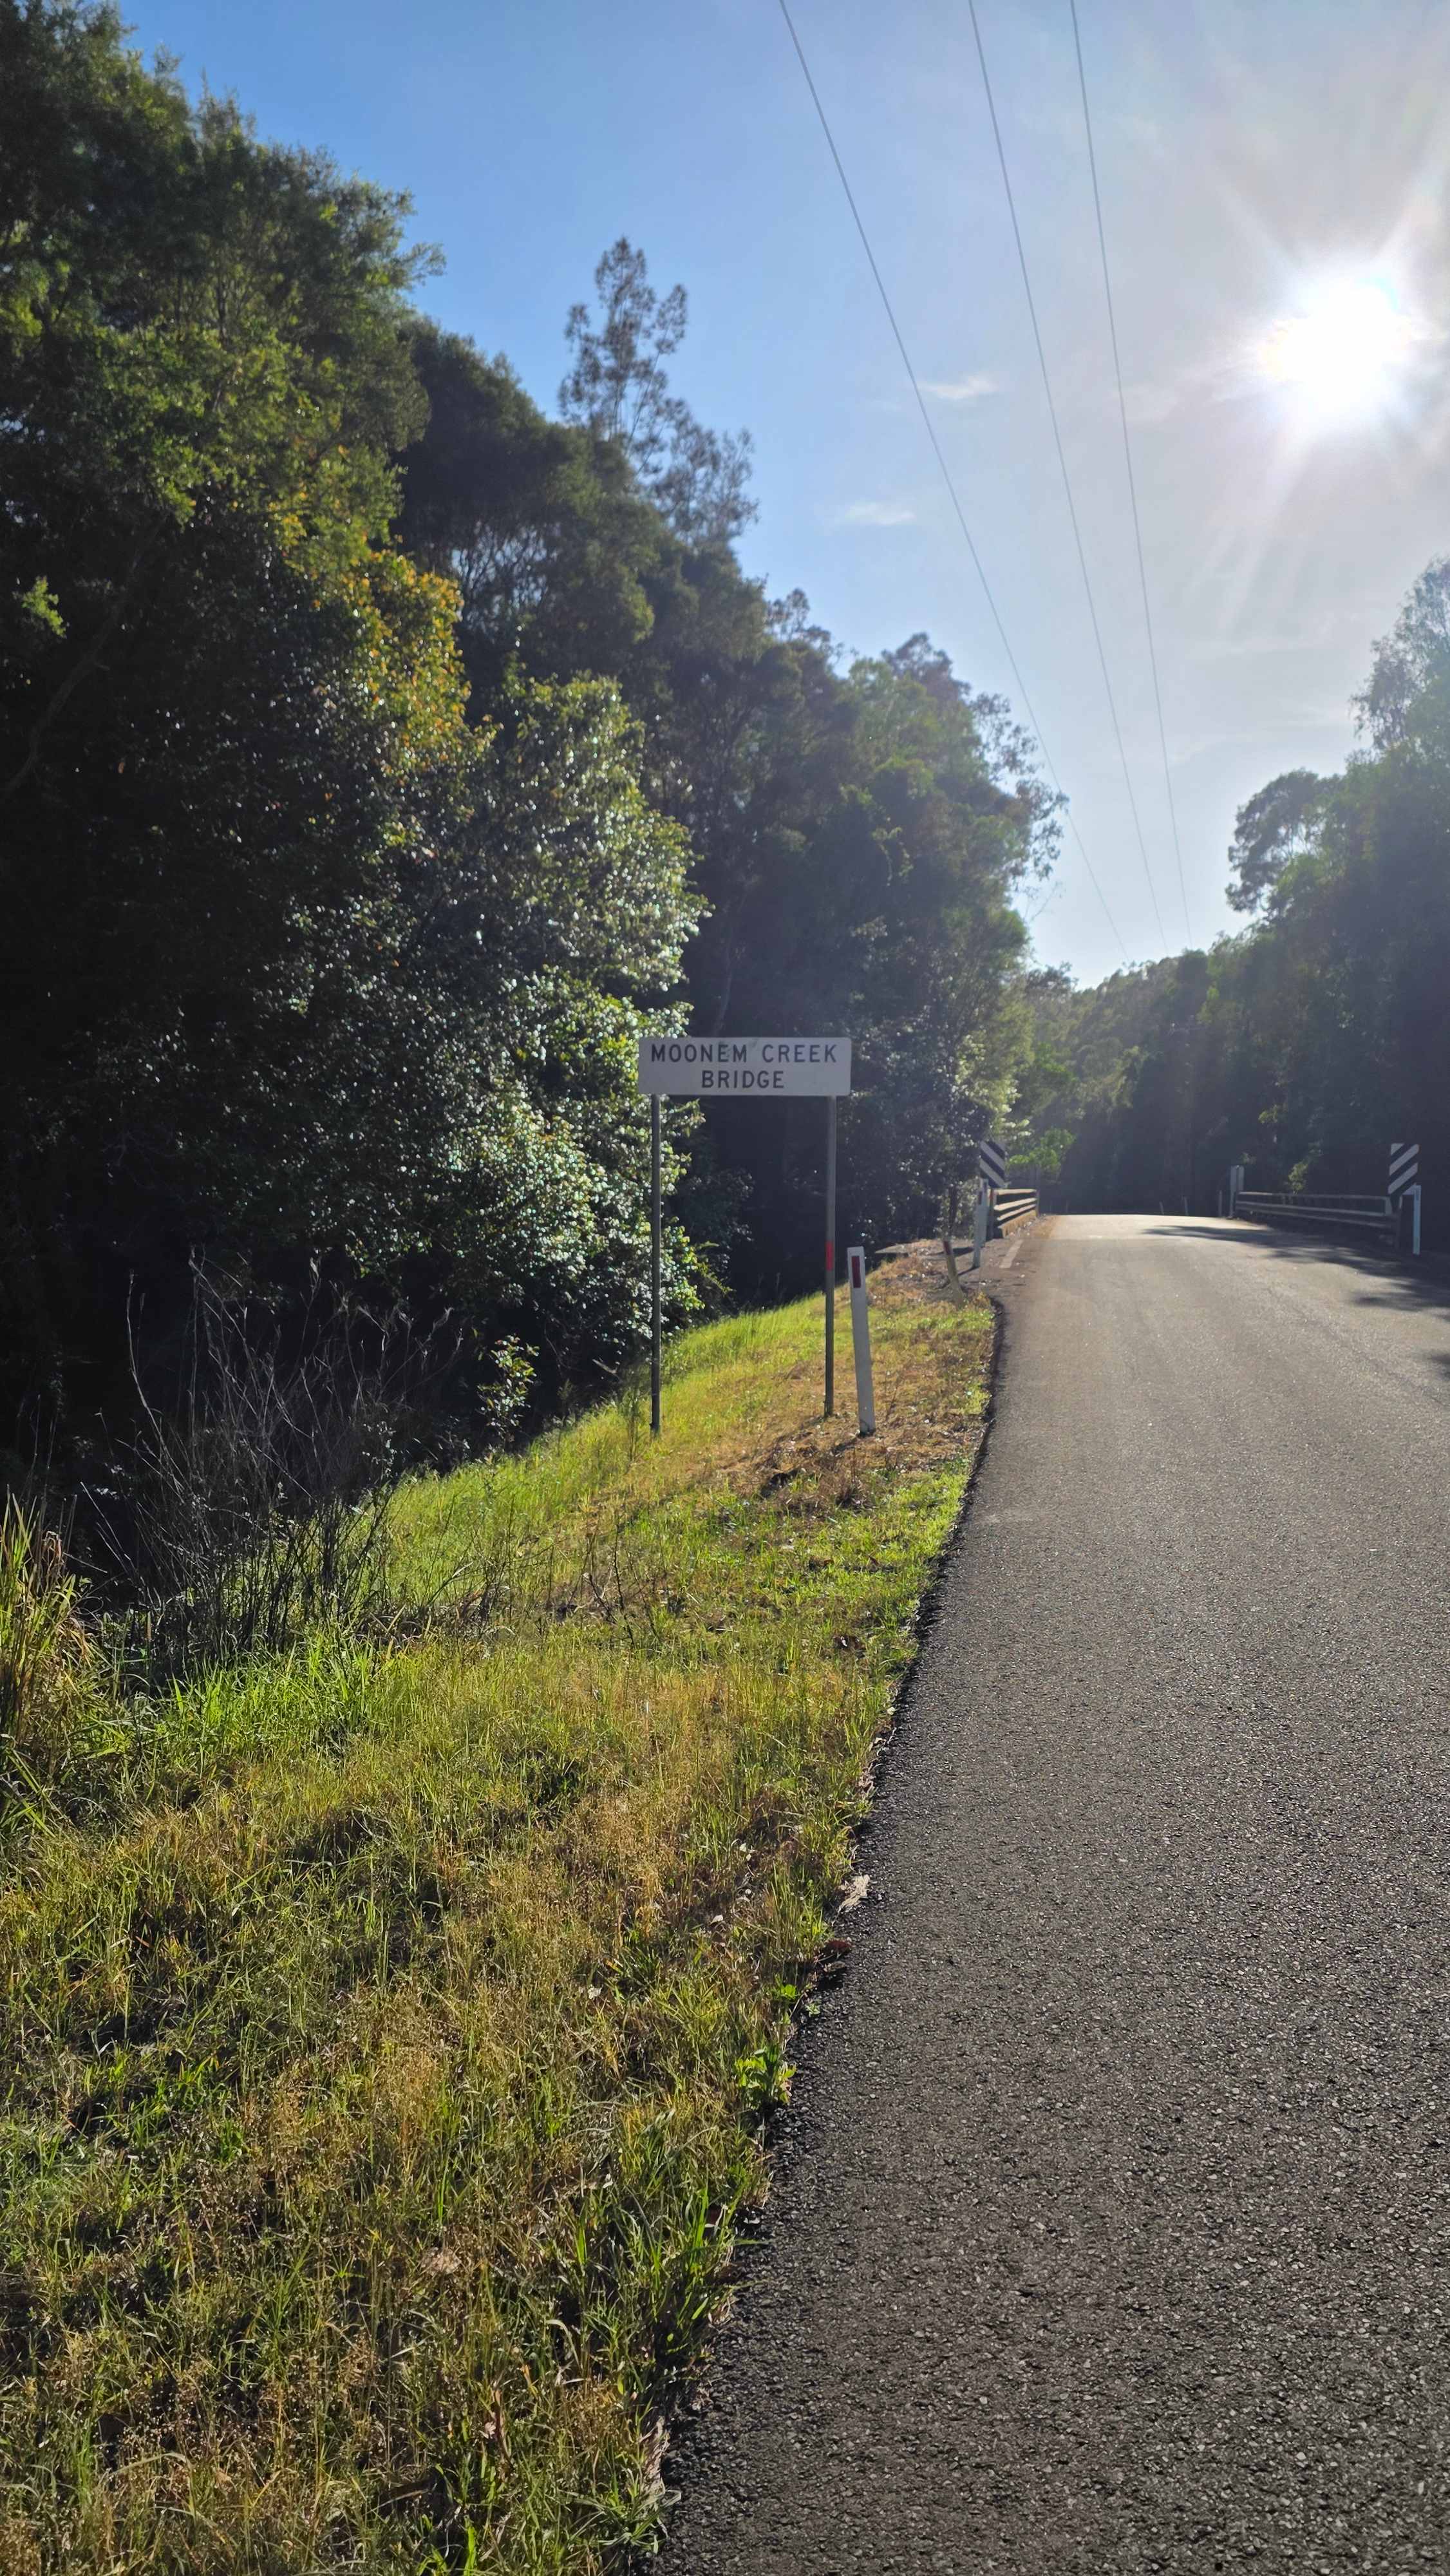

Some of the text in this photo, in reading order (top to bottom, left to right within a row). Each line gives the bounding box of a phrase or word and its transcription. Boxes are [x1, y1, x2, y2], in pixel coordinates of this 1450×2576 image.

[651, 1044, 837, 1063] MOONEM CREEK
[701, 1070, 784, 1088] BRIDGE
